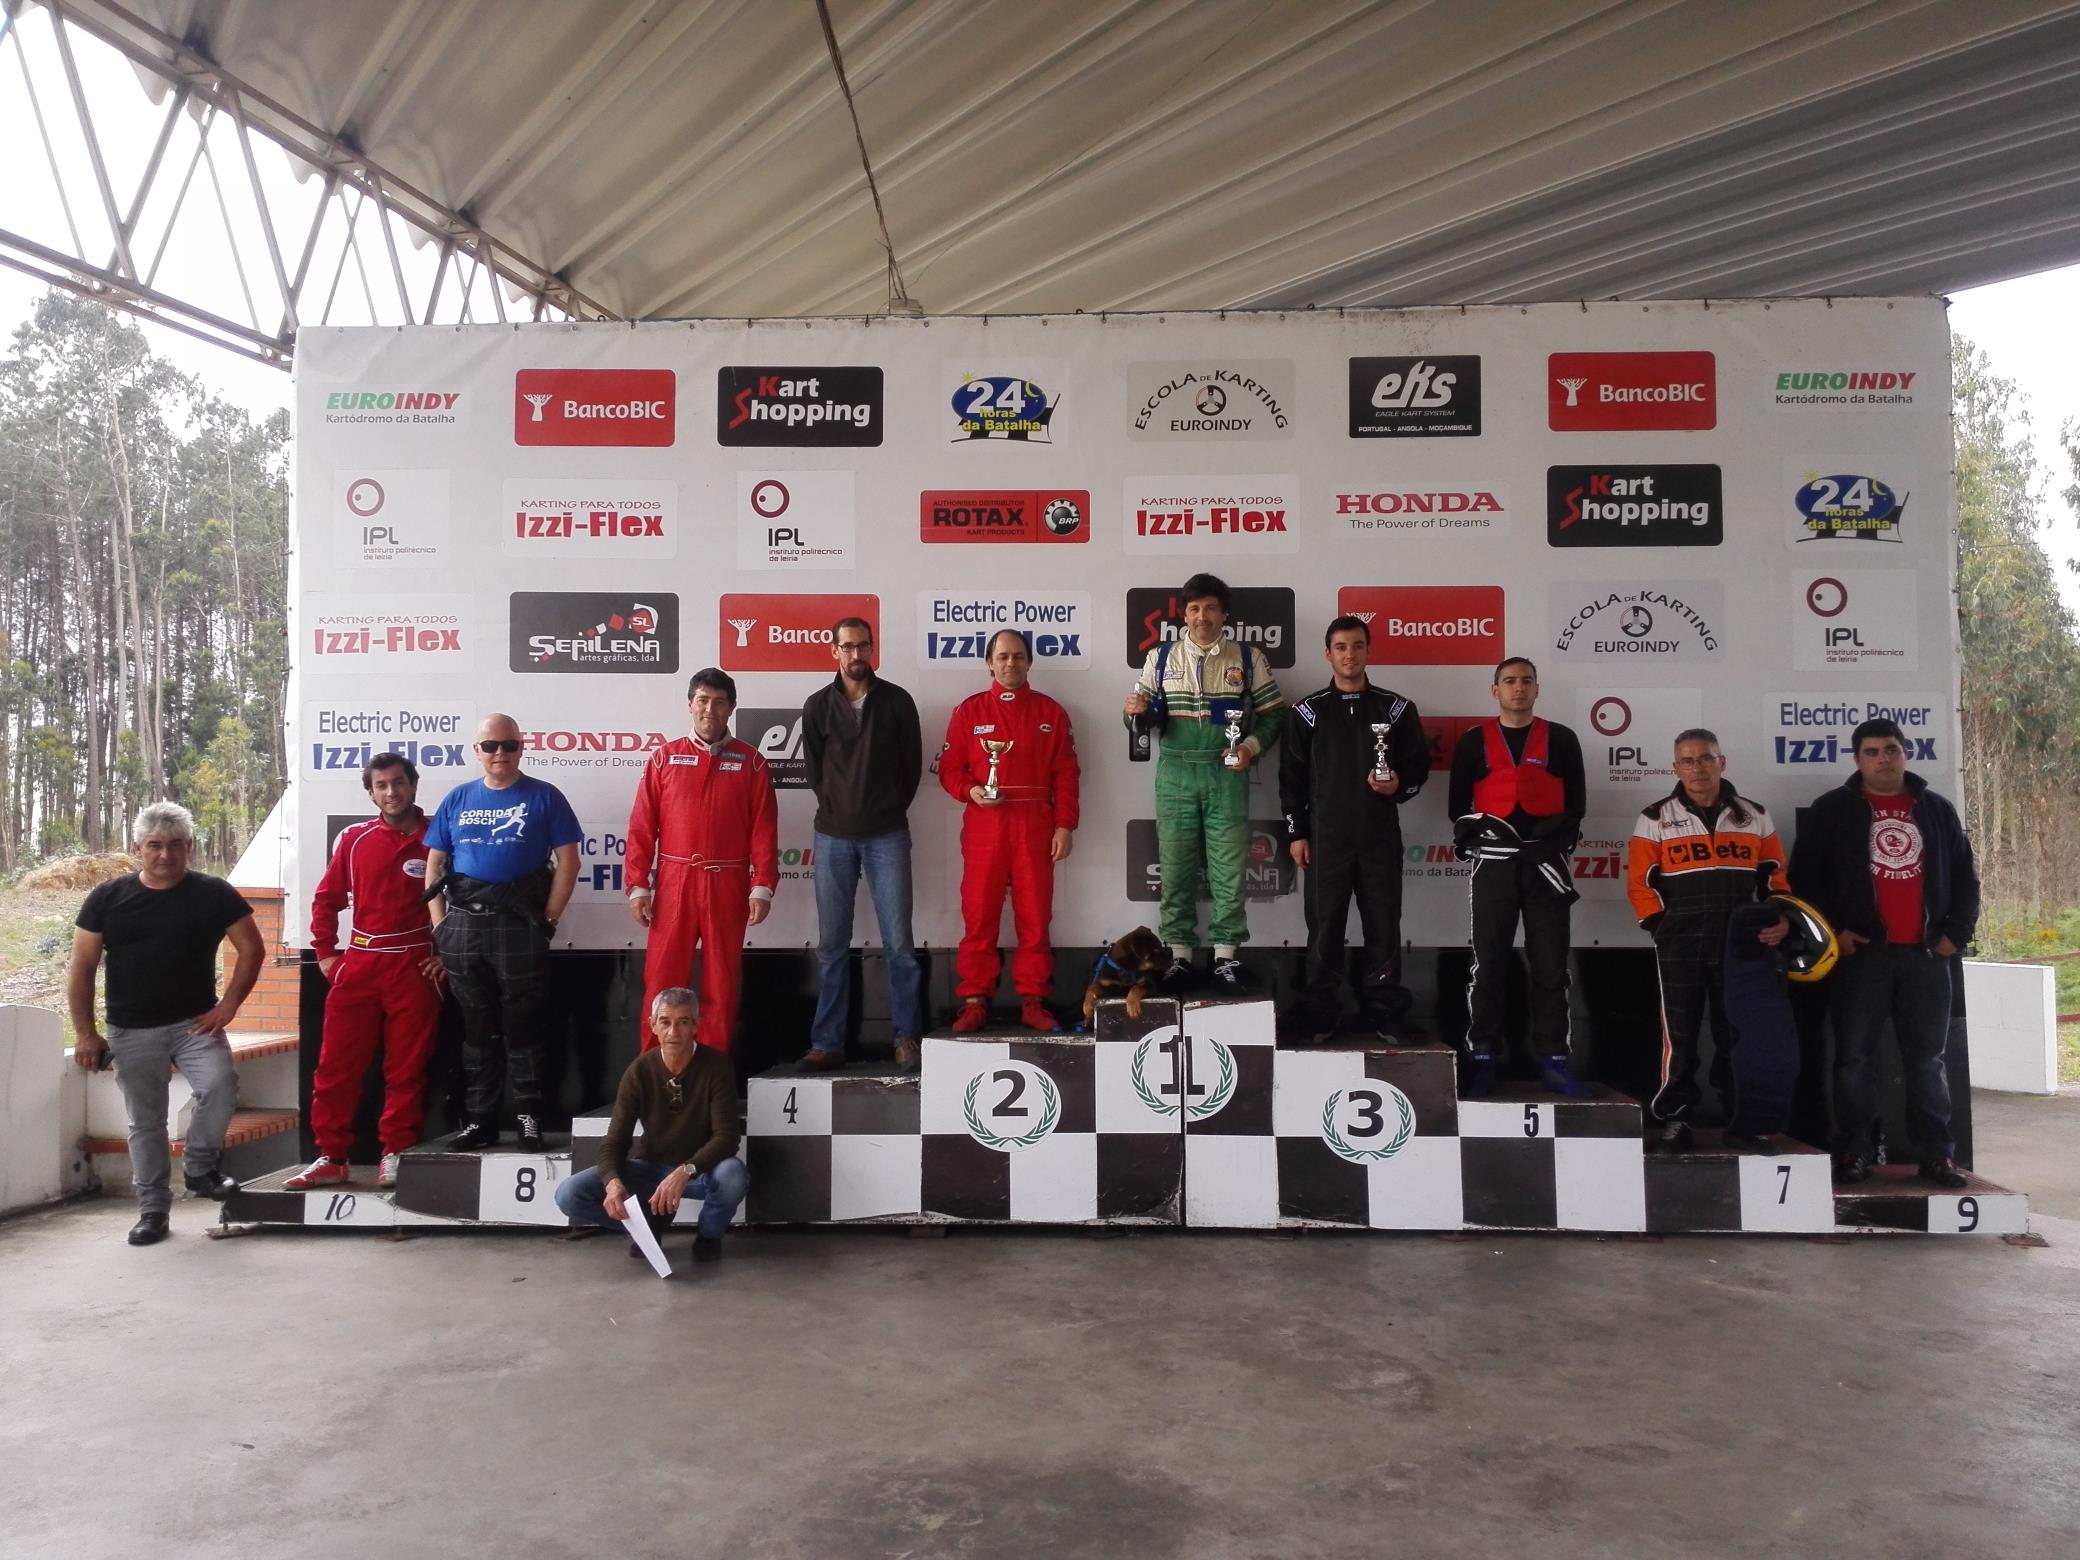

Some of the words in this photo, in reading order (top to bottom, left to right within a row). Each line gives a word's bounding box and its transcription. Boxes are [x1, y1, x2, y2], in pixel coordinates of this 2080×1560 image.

[759, 376, 819, 398] Kart
[1776, 372, 1916, 390] EUROINDY
[326, 392, 460, 410] EUROINDY
[966, 380, 1025, 414] 24
[1135, 372, 1198, 431] ESCOLA
[1214, 369, 1288, 430] KARTING
[1599, 383, 1706, 403] BancoBIC
[1776, 394, 1847, 405] Kartódromo
[1850, 394, 1865, 404] da
[1867, 394, 1913, 404] Batalha
[563, 400, 665, 419] BancoBIC
[729, 388, 871, 429] Shopping
[979, 407, 1017, 419] horas
[326, 414, 393, 424] Kartódromo
[396, 414, 410, 424] da
[413, 414, 455, 424] Batalha
[962, 419, 982, 431] da
[985, 419, 1041, 431] Batalha
[1170, 419, 1253, 432] EUROINDY
[1591, 474, 1654, 497] Kart
[520, 500, 578, 509] KARTING
[580, 500, 615, 509] PARA
[618, 500, 661, 509] TODOS
[1141, 497, 1198, 506] KARTING
[1201, 497, 1236, 506] PARA
[1239, 496, 1283, 505] TODOS
[1336, 492, 1504, 514] HONDA
[1810, 479, 1873, 513] 24
[1560, 488, 1709, 530] Shopping
[1825, 506, 1864, 517] horas
[516, 511, 664, 538] Izzi-Flex
[1136, 507, 1287, 536] Izzi-Flex
[1350, 518, 1373, 529] The
[1377, 518, 1417, 529] Power
[1419, 518, 1435, 529] of
[1439, 517, 1490, 528] Dreams
[1807, 518, 1827, 530] da
[1831, 518, 1891, 531] Batalha
[363, 526, 399, 545] IPL
[768, 528, 805, 546] IPL
[318, 615, 374, 624] KARTING
[376, 615, 411, 624] PARA
[413, 615, 458, 624] TODOS
[934, 600, 1007, 623] Electric
[1014, 600, 1076, 623] Power
[1557, 593, 1622, 652] ESCOLA
[1640, 591, 1718, 652] KARTING
[632, 617, 650, 627] SL
[1388, 618, 1494, 638] BancoBIC
[314, 627, 461, 655] Izzi-Flex
[768, 625, 833, 644] Banco
[1826, 627, 1864, 647] IPL
[1594, 640, 1680, 653] EUROINDY
[1826, 648, 1858, 656] instituto
[319, 711, 392, 733] Electric
[400, 711, 461, 733] Power
[1780, 702, 1859, 726] Electric
[525, 757, 548, 766] The
[552, 757, 591, 766] Power
[595, 757, 608, 766] of
[1609, 747, 1647, 766] IPL
[459, 818, 496, 826] BOSCH
[461, 809, 513, 818] CORRIDA
[1691, 841, 1752, 860] Beta
[1427, 868, 1442, 877] da
[1158, 1034, 1206, 1096] 1
[991, 1069, 1029, 1118] 2
[783, 1087, 798, 1124] 4
[1346, 1089, 1385, 1138] 3
[1523, 1103, 1540, 1138] 5
[514, 1166, 536, 1204] 8
[1776, 1164, 1792, 1205] 7
[324, 1194, 357, 1222] 10
[1957, 1196, 1980, 1233] 9
